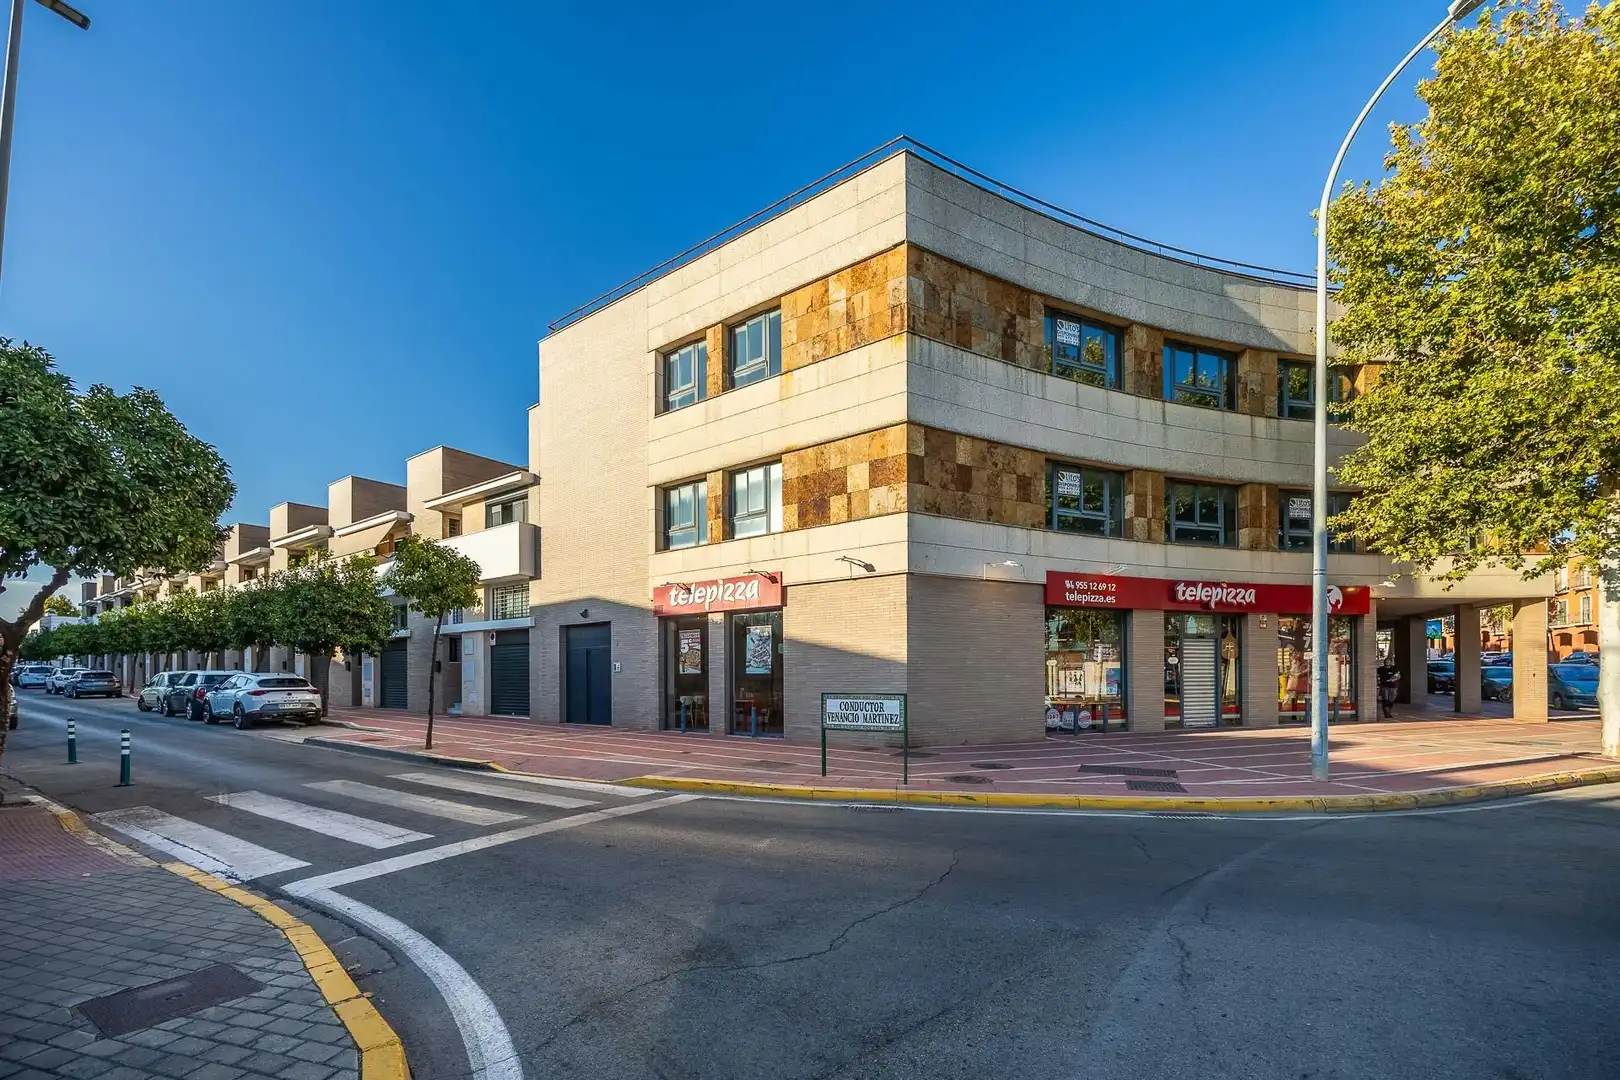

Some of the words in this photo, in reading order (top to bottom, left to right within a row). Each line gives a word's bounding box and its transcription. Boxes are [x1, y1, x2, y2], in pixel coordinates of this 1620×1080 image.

[1075, 581, 1088, 590] 955
[1089, 582, 1098, 591] 12
[1098, 583, 1107, 591] 69
[1108, 583, 1117, 592] 12
[669, 579, 759, 612] telepizza
[1065, 590, 1116, 604] telepizza.es
[1176, 582, 1256, 609] telepizza
[839, 701, 885, 713] CONDUCTOR
[827, 711, 860, 723] VENANCIO
